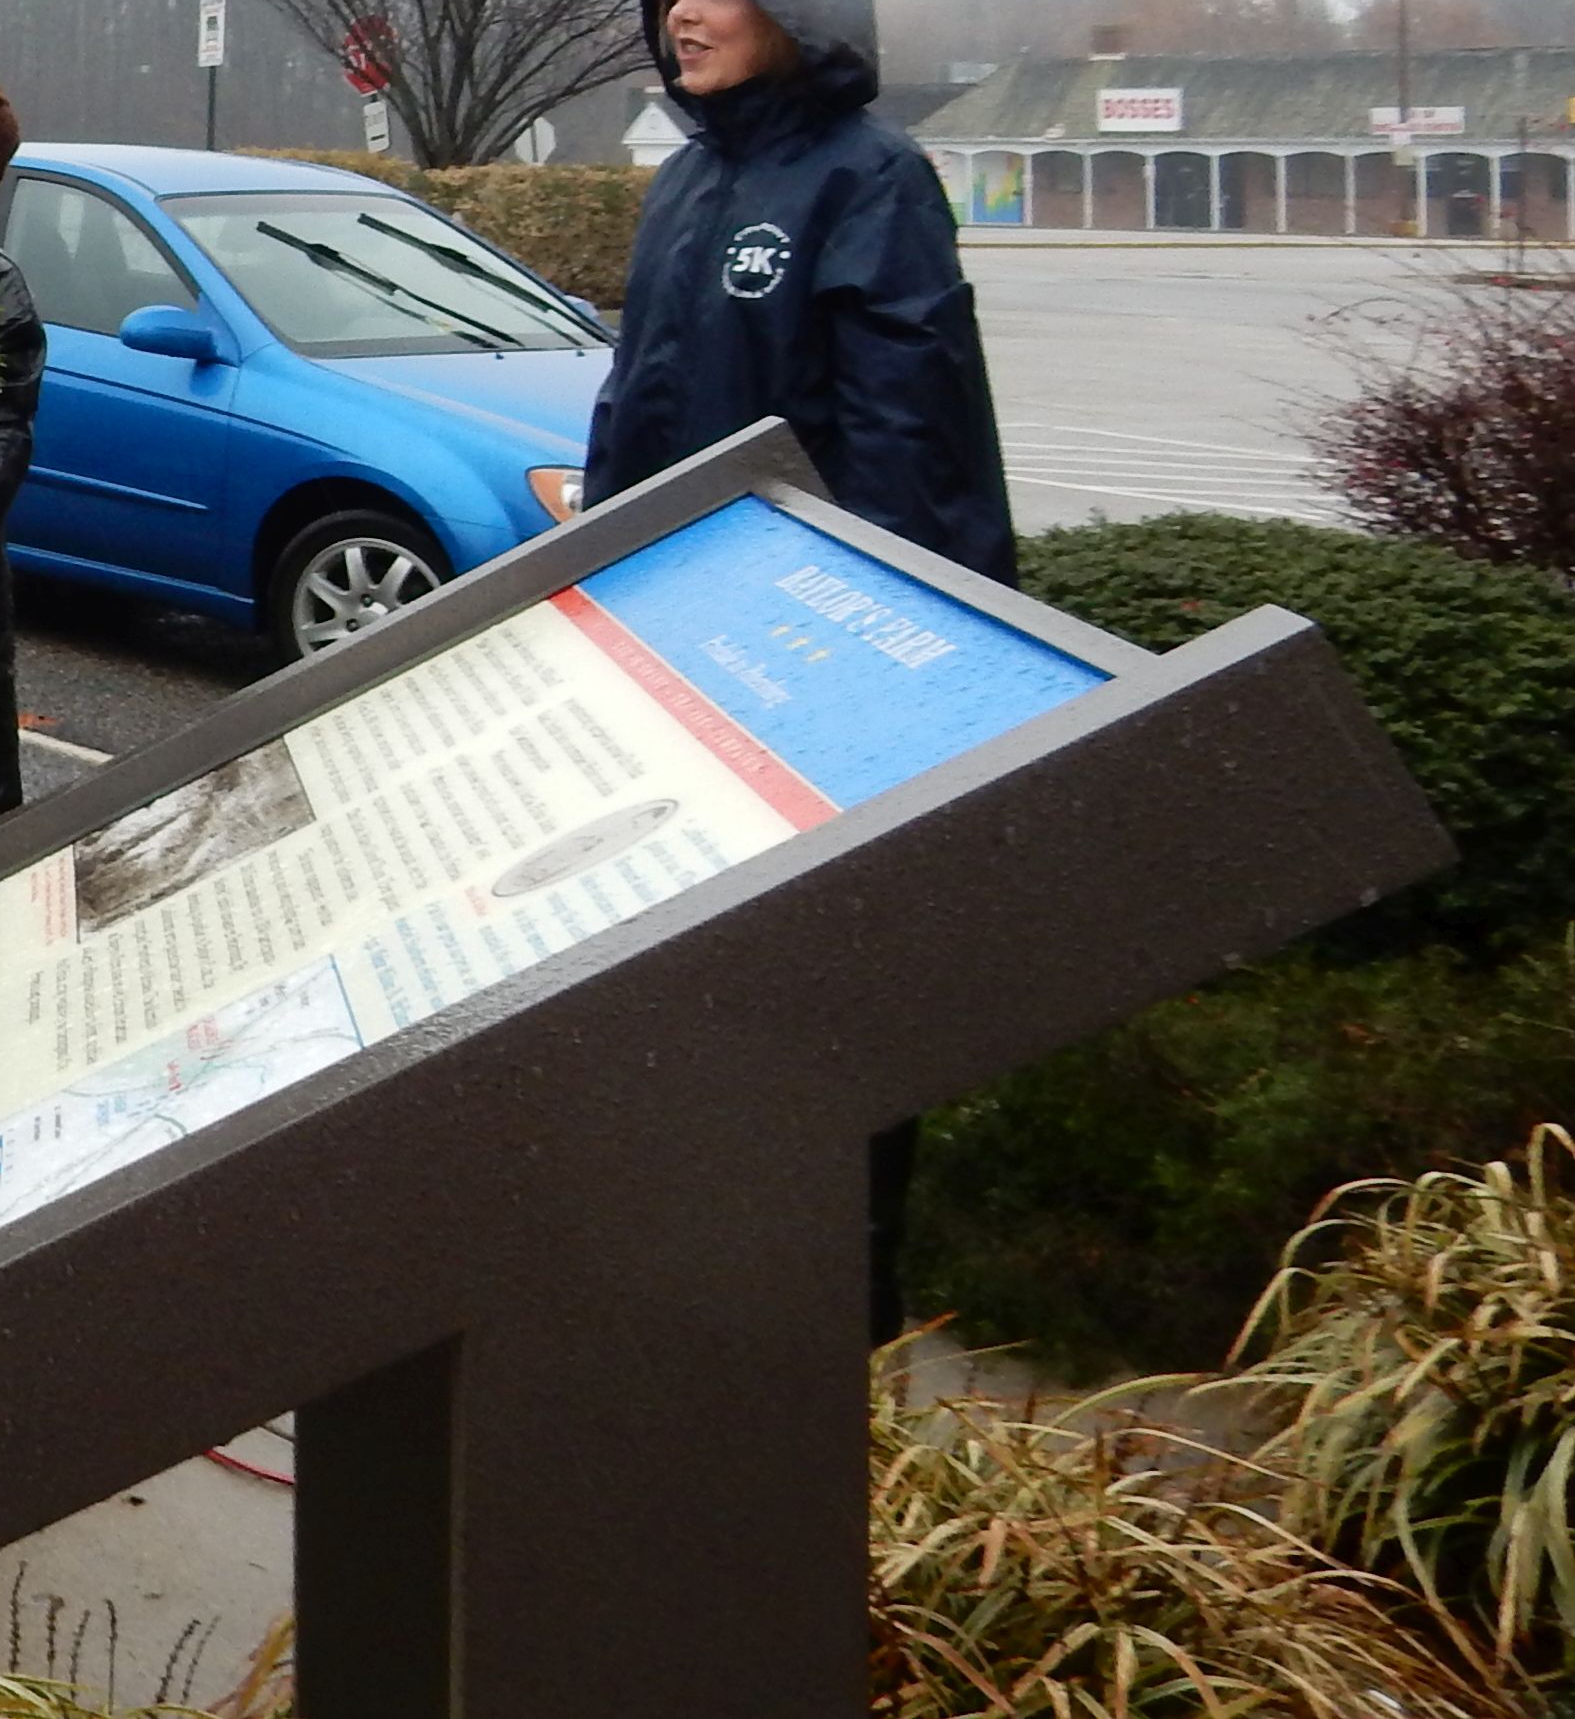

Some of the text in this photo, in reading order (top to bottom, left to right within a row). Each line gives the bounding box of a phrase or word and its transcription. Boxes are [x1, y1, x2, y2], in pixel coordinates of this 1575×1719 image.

[732, 246, 776, 275] 5K
[775, 565, 957, 669] BAYLOR'S FARM
